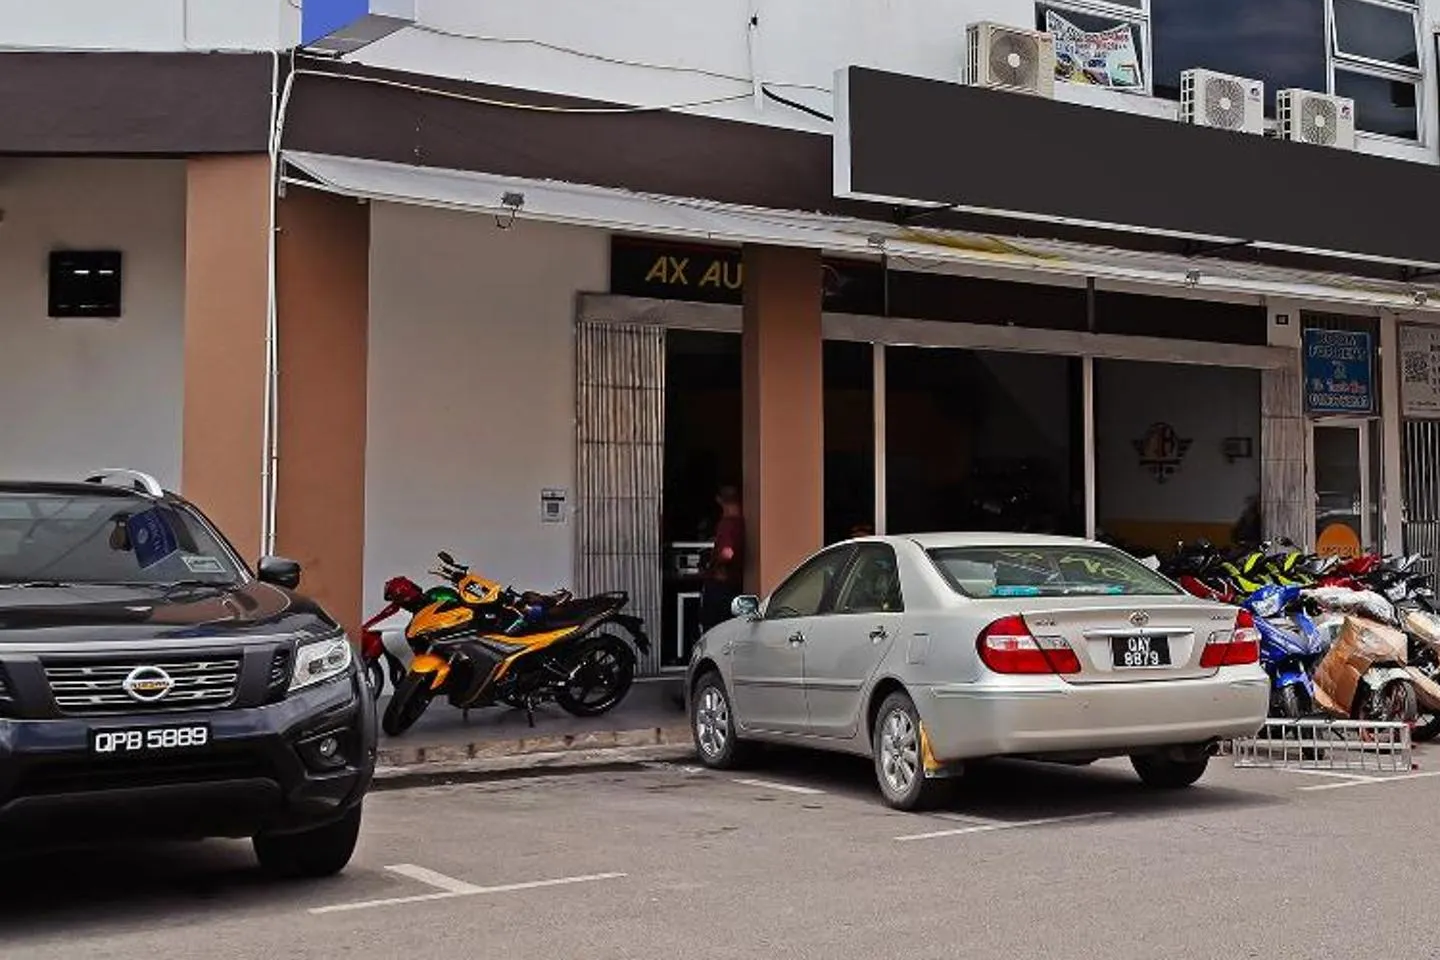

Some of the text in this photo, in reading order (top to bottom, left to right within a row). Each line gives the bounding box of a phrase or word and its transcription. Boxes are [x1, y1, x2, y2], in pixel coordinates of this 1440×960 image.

[645, 255, 689, 285] AX
[95, 727, 207, 752] QPB 5889
